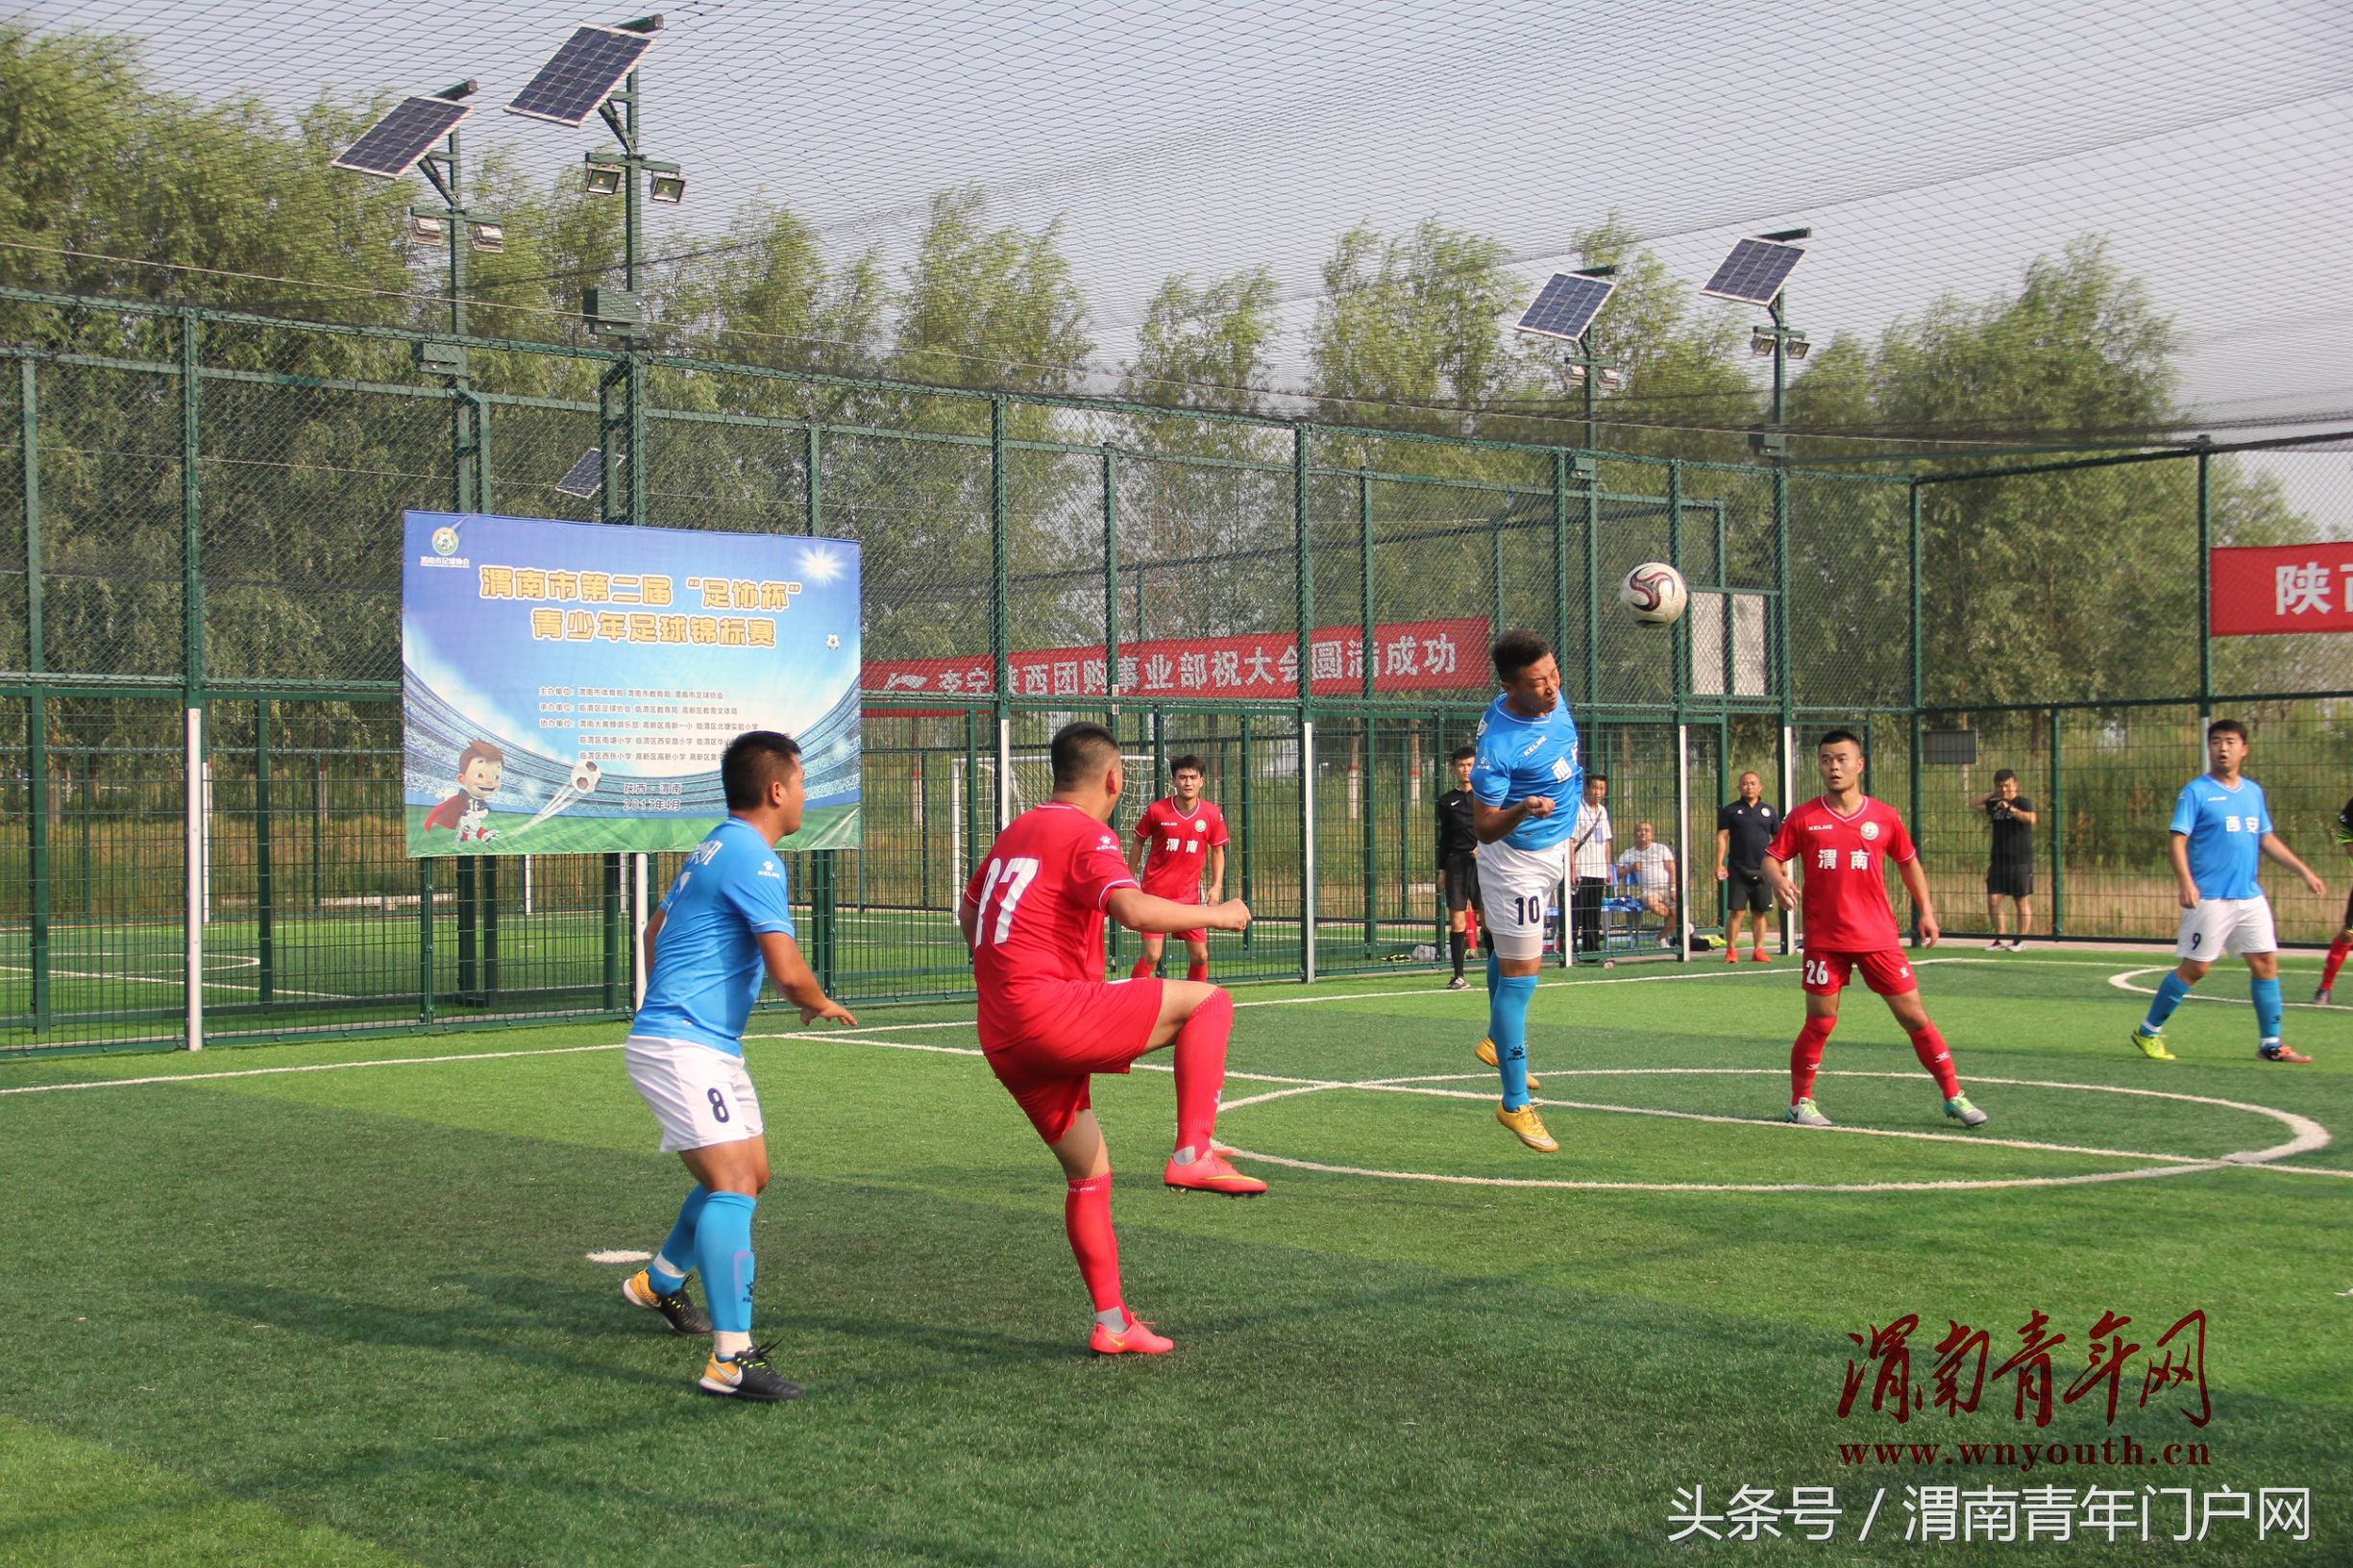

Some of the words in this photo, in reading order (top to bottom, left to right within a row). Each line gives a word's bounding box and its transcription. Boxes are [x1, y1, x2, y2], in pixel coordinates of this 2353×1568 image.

[2275, 561, 2353, 616] 陕
[530, 609, 777, 649] 青少年足球锦标赛
[1522, 735, 1548, 757] KELME
[623, 798, 681, 811] 2017年4月
[1818, 848, 1871, 870] 渭南
[1514, 895, 1541, 925] 10
[2192, 932, 2202, 951] 9
[1805, 960, 1829, 986] 26
[707, 1087, 730, 1123] 8
